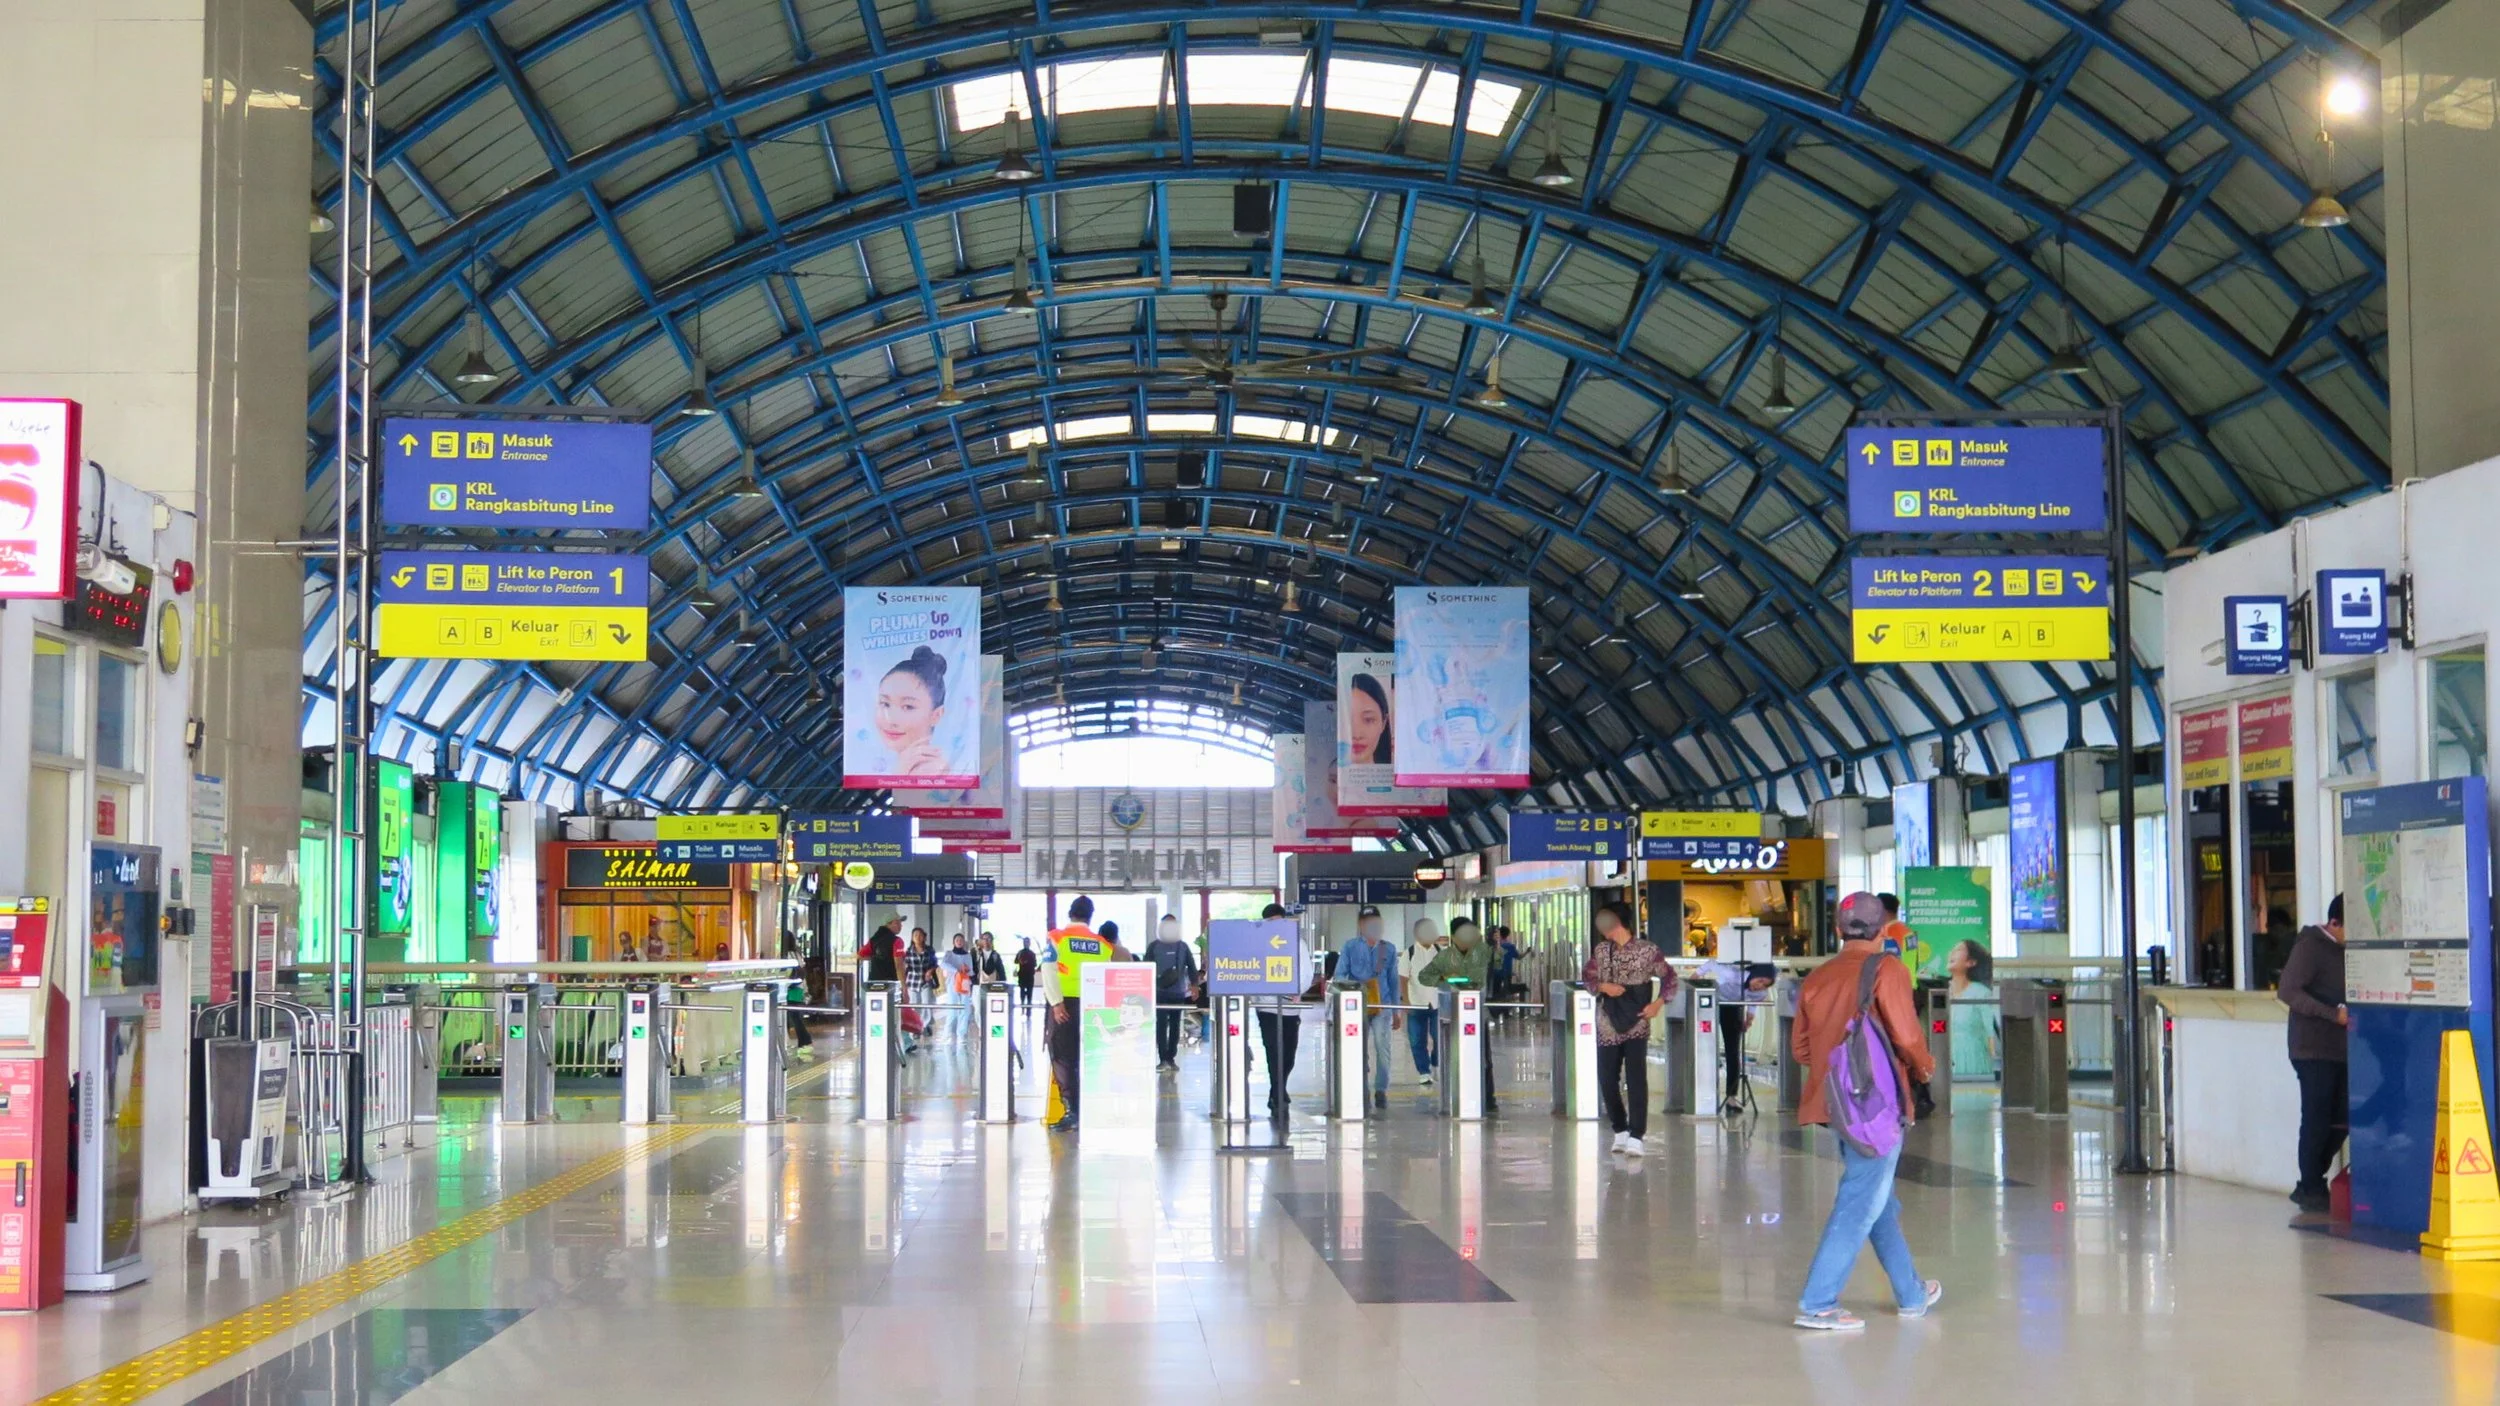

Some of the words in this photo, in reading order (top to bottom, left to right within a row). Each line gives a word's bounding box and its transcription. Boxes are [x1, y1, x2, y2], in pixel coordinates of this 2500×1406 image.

[502, 433, 552, 448] Masuk
[1960, 440, 2008, 454] Masuk
[501, 451, 548, 461] Entrance
[1960, 457, 2005, 466] Entrance
[466, 482, 496, 496] KRL
[1929, 488, 1958, 501] KRL
[466, 498, 578, 516] Rangkasbitung
[582, 500, 614, 514] Line
[1929, 504, 2036, 519] Rangkasbitung
[2040, 504, 2070, 516] Line
[498, 566, 522, 580] Lift
[528, 566, 545, 580] ke
[548, 567, 592, 580] Peron
[608, 568, 624, 595] 1
[1874, 570, 1898, 582] Lift
[1900, 570, 1918, 582] ke
[1921, 570, 1961, 583] Peron
[1972, 570, 1992, 596] 2
[496, 583, 540, 594] Elevator
[542, 584, 552, 594] to
[555, 584, 600, 594] Platform
[1868, 587, 1907, 597] Elevator
[1908, 588, 1919, 596] to
[1920, 586, 1962, 597] Platform
[891, 594, 948, 602] SOMETHINC
[1440, 594, 1497, 602] SOMETHINC
[869, 612, 928, 634] PLUMP
[930, 610, 950, 626] Up
[447, 626, 458, 638] A
[484, 627, 493, 638] B
[511, 620, 559, 632] Keluar
[1940, 622, 1986, 634] Keluar
[2002, 629, 2012, 641] A
[2037, 628, 2046, 640] B
[540, 636, 559, 647] Exit
[862, 628, 928, 650] WRINKLES
[929, 626, 962, 640] Down
[2362, 632, 2376, 640] Staf
[1940, 640, 1958, 648] Exit
[2238, 654, 2260, 662] Barang
[2262, 654, 2282, 662] Hilang
[2242, 706, 2272, 723] Customer
[852, 820, 860, 832] 1
[1556, 818, 1576, 826] Peron
[1580, 818, 1590, 830] 2
[1547, 844, 1570, 852] Tanah
[1572, 844, 1592, 852] Abang
[606, 860, 691, 878] SALMAN
[1214, 958, 1261, 970] Masuk
[1216, 972, 1261, 982] Entrance
